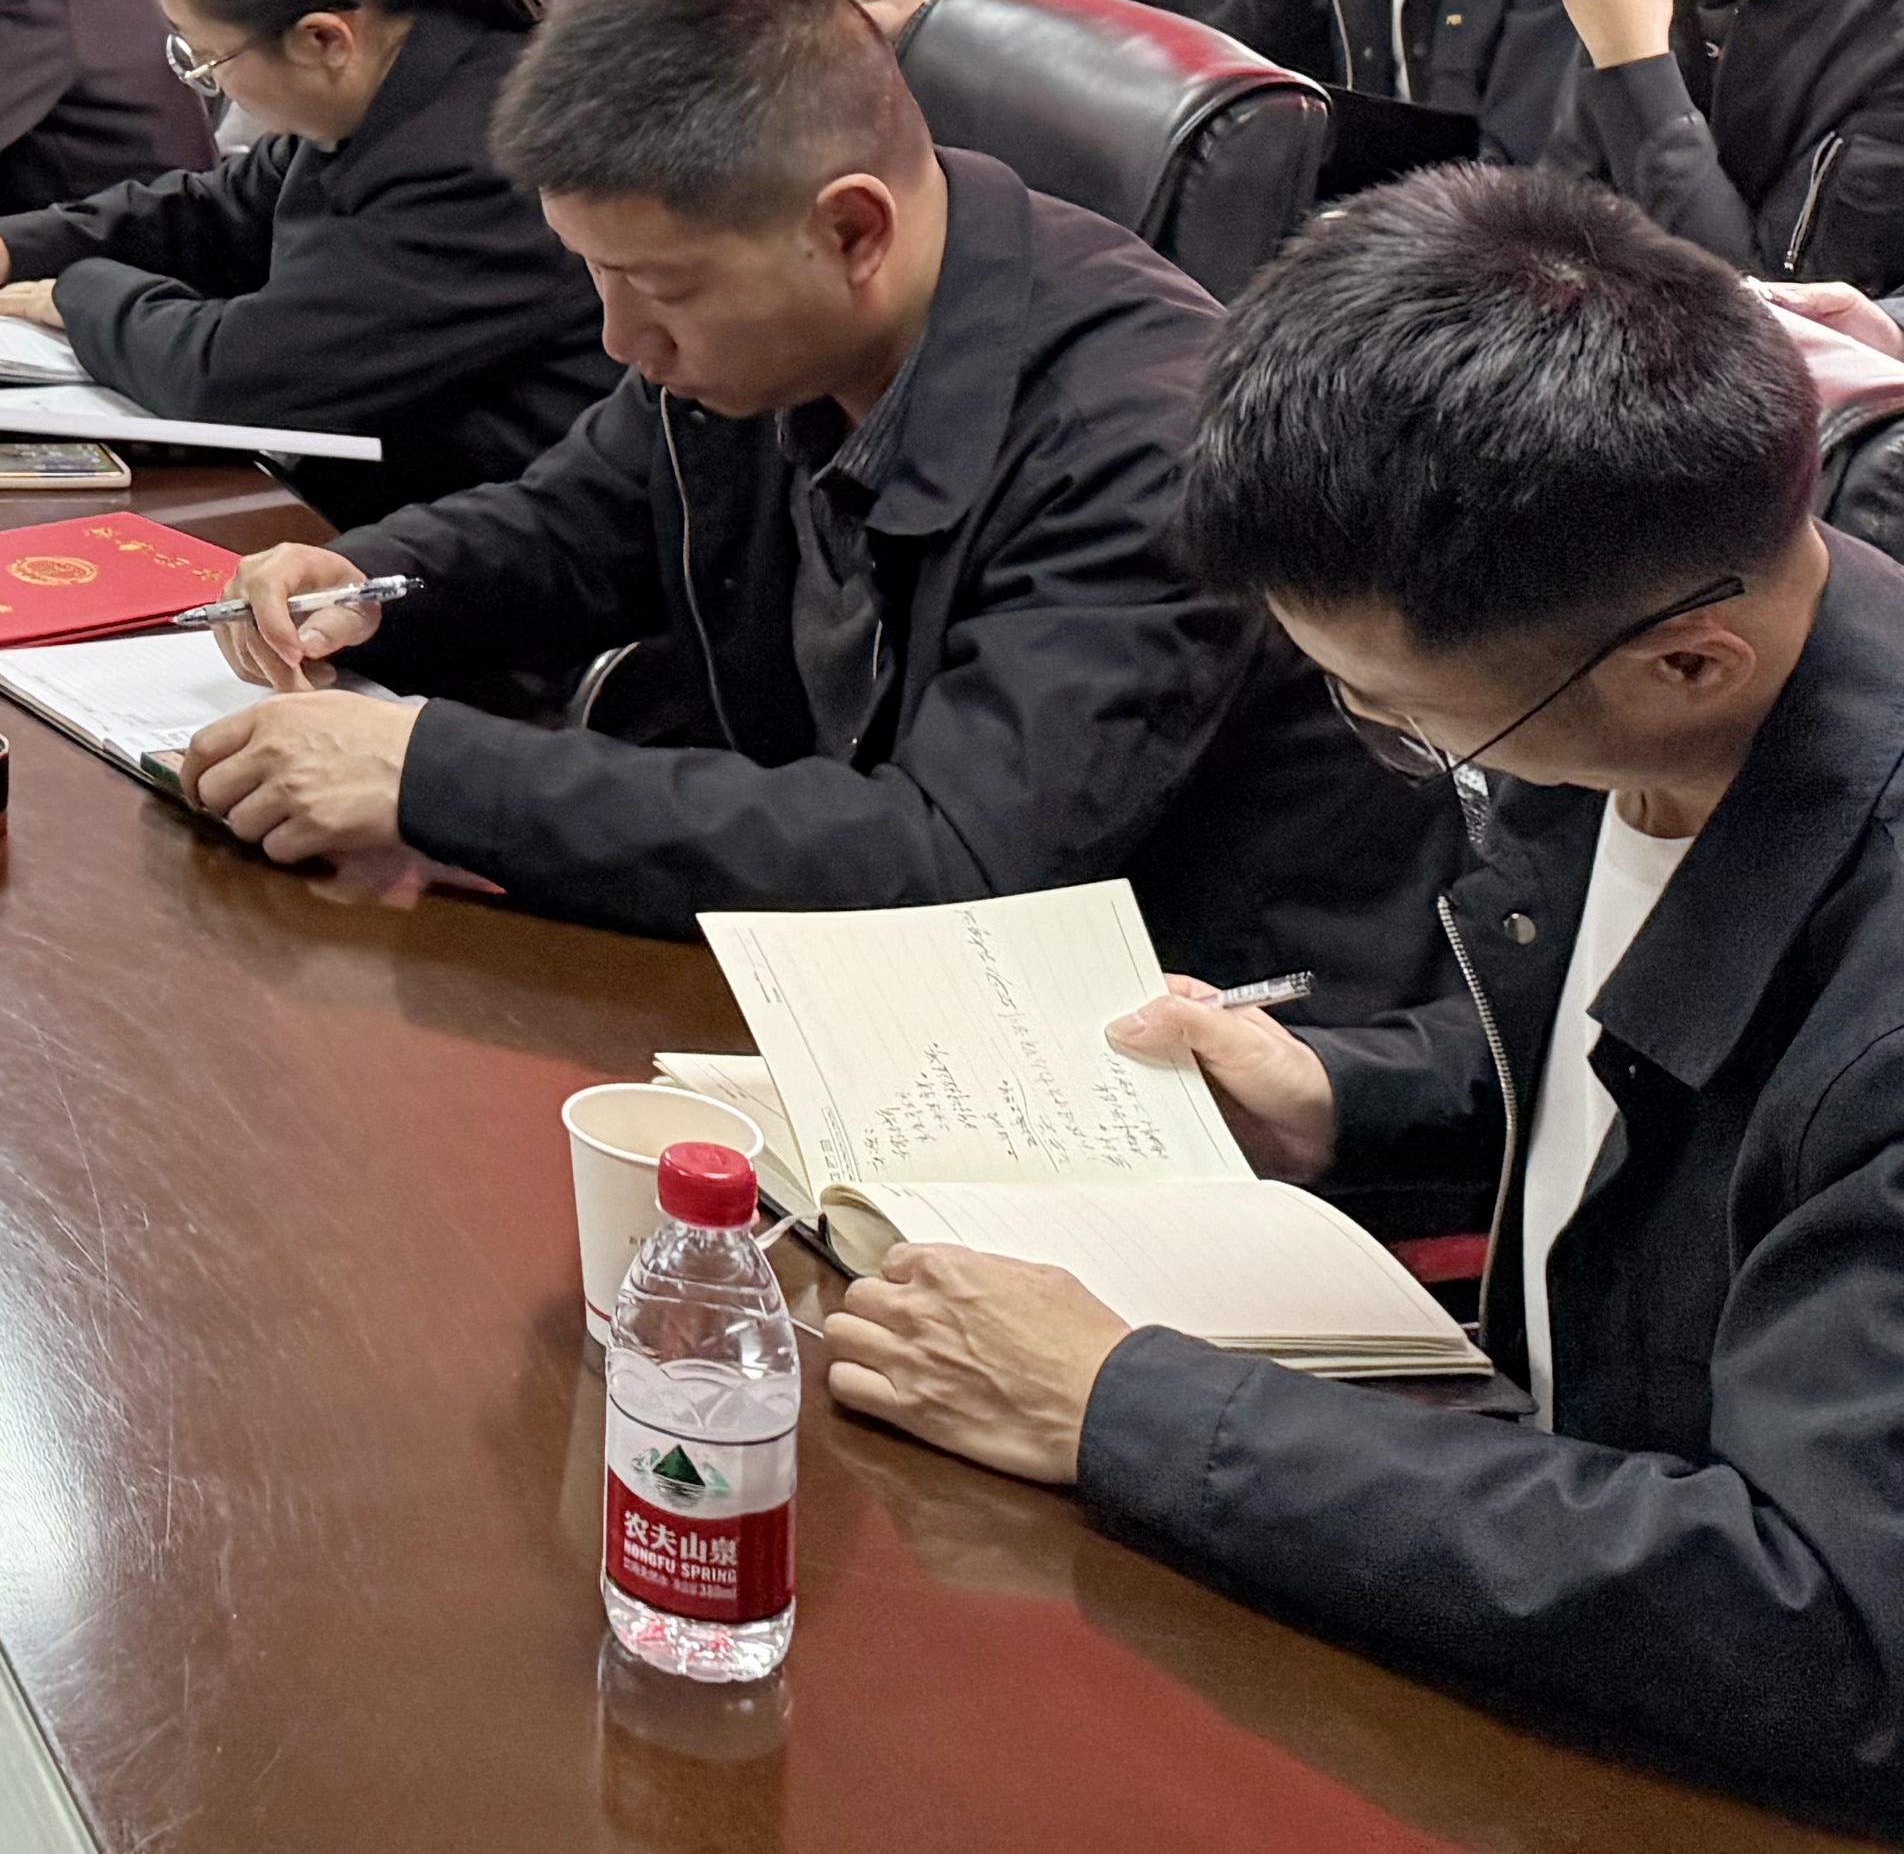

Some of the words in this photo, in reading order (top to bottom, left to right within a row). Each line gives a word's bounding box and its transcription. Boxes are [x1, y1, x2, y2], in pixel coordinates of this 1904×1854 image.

[624, 1510, 739, 1566] 农夫山泉
[624, 1537, 676, 1574] NONGFU
[680, 1562, 737, 1583] SPRING
